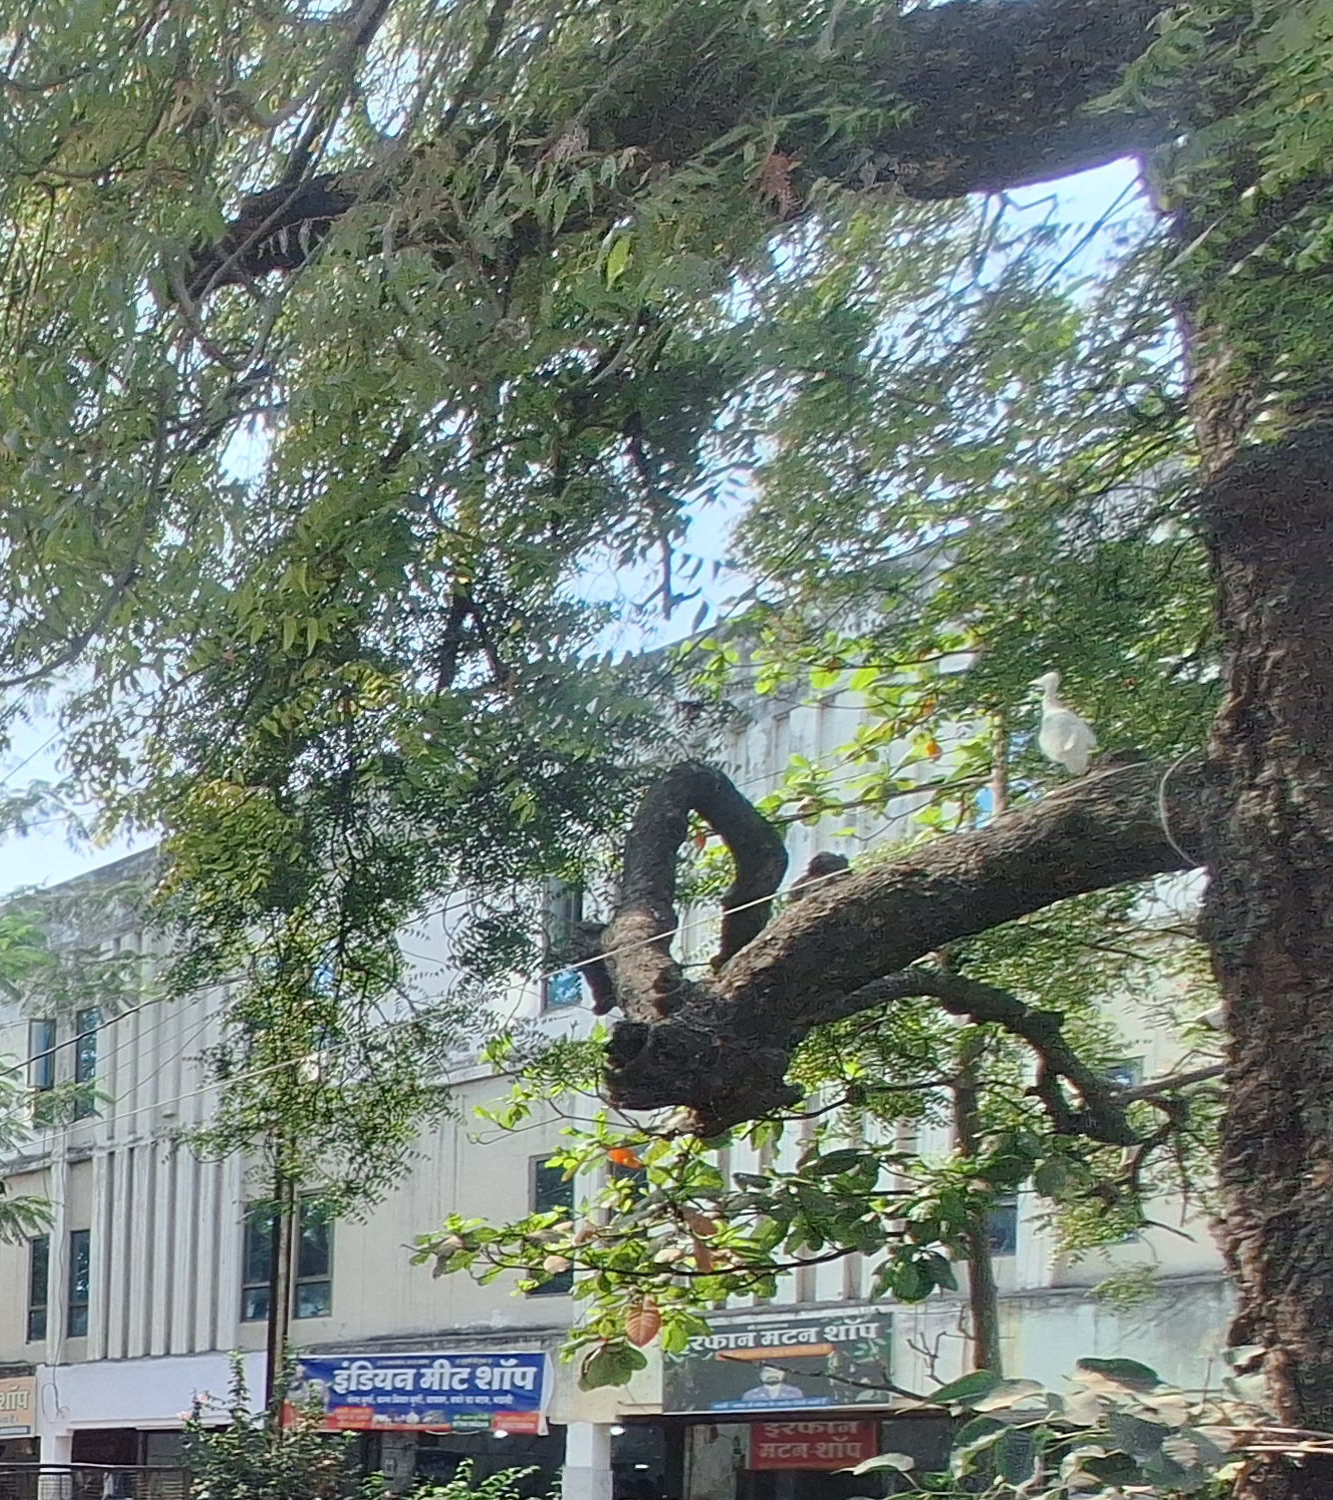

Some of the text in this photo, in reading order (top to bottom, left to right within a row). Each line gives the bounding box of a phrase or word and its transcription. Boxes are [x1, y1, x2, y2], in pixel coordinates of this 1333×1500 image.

[761, 1327, 819, 1345] मटन
[823, 1317, 879, 1340] शॉप
[333, 1358, 537, 1394] इंडियन मीट शॉप
[759, 1436, 862, 1458] मटन शॉप
